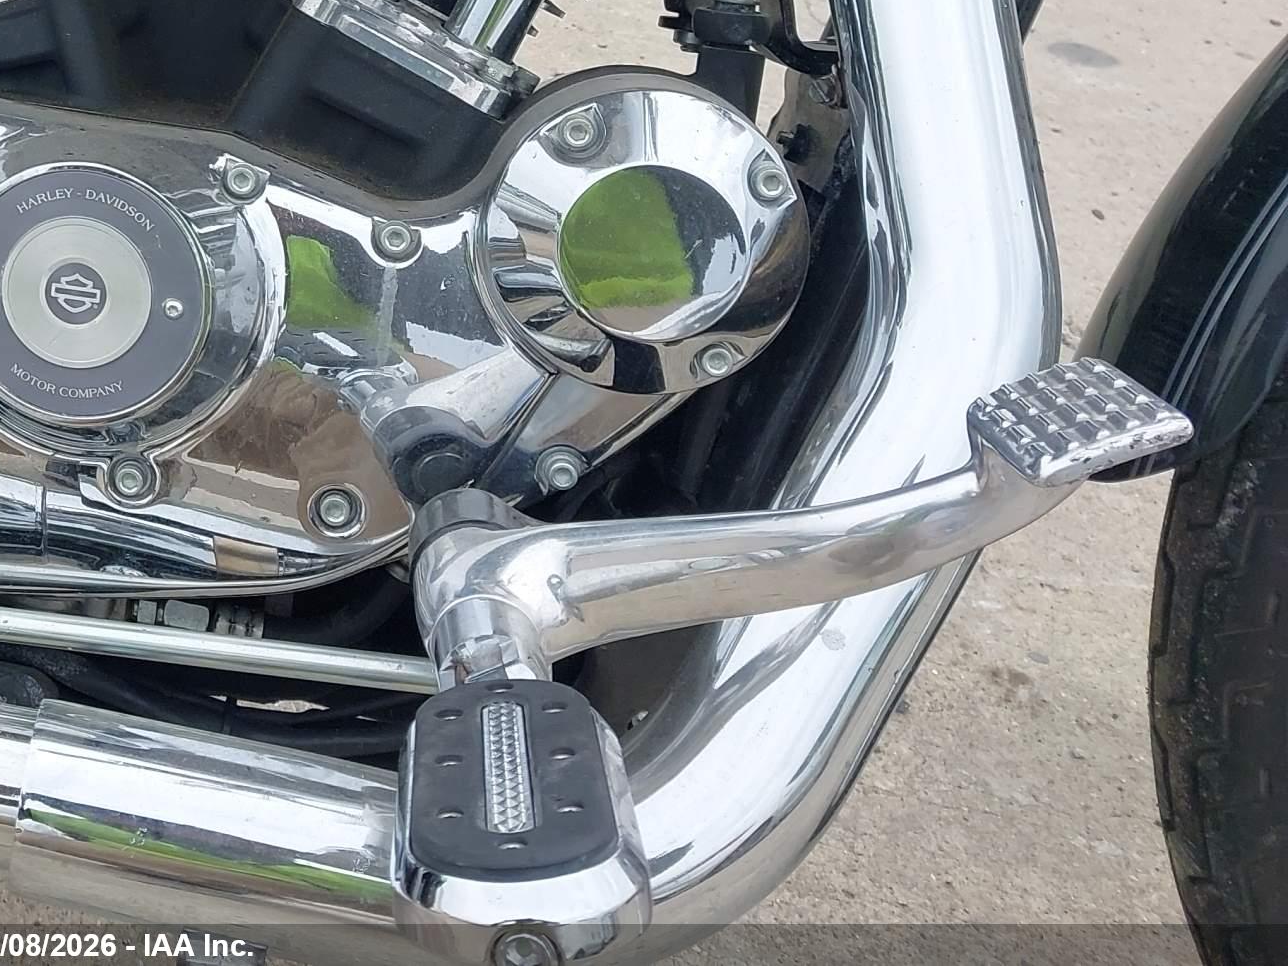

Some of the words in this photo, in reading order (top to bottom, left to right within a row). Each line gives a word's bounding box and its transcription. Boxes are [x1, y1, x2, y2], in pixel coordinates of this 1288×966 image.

[16, 188, 74, 214] HARLEY
[85, 189, 155, 231] DAVIDSON
[11, 363, 56, 395] MOTOR
[59, 380, 123, 398] COMPANY
